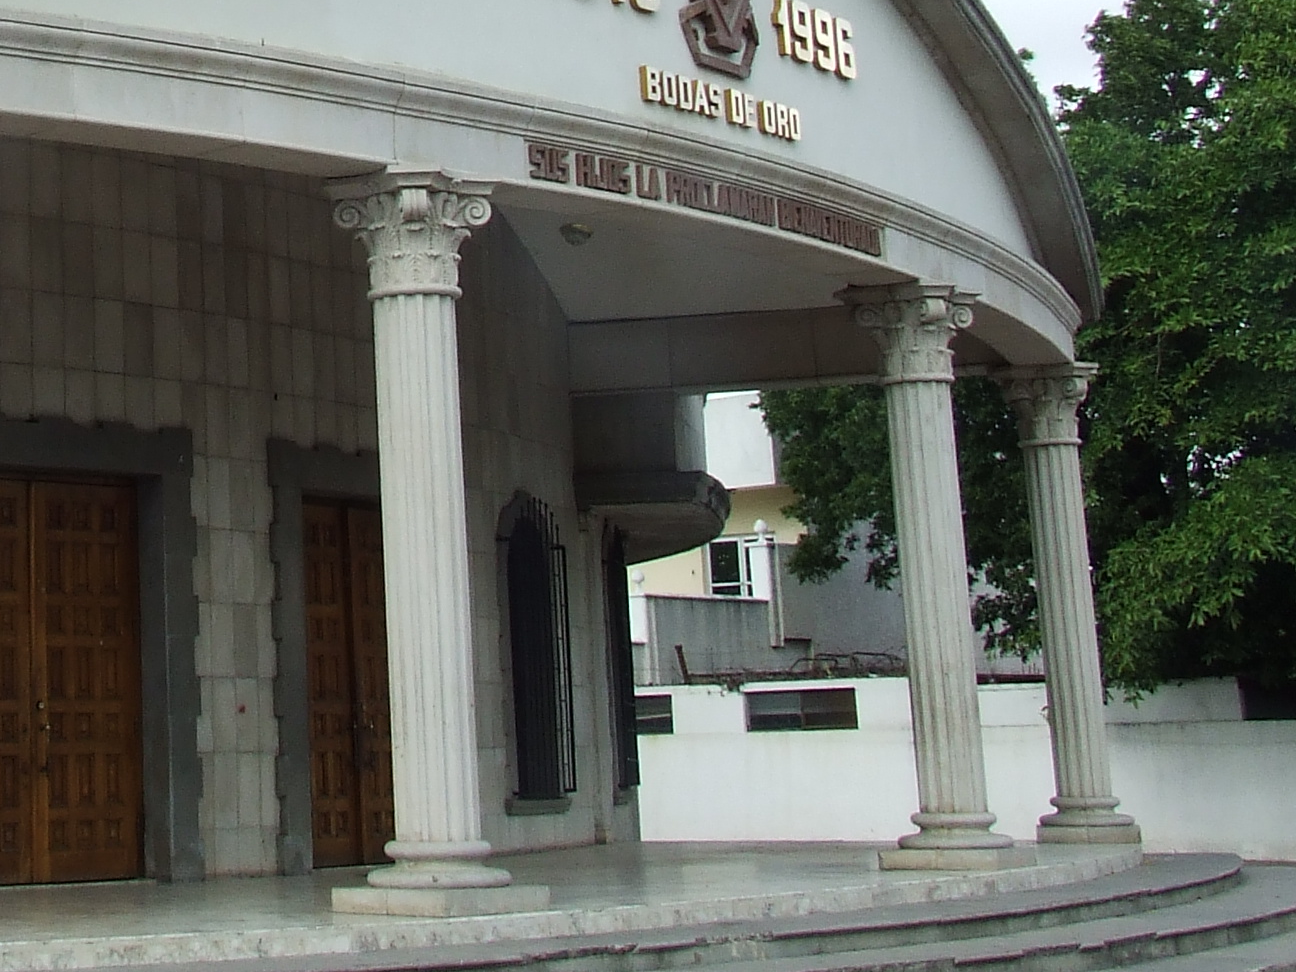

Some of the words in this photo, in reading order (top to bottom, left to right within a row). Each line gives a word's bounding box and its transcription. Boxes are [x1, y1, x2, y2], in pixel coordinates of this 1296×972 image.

[639, 64, 722, 118] BODAS
[724, 88, 756, 128] DE
[757, 99, 801, 141] ORO
[528, 144, 570, 183] SUS
[575, 153, 631, 194] HIJOS
[635, 165, 661, 201] LA
